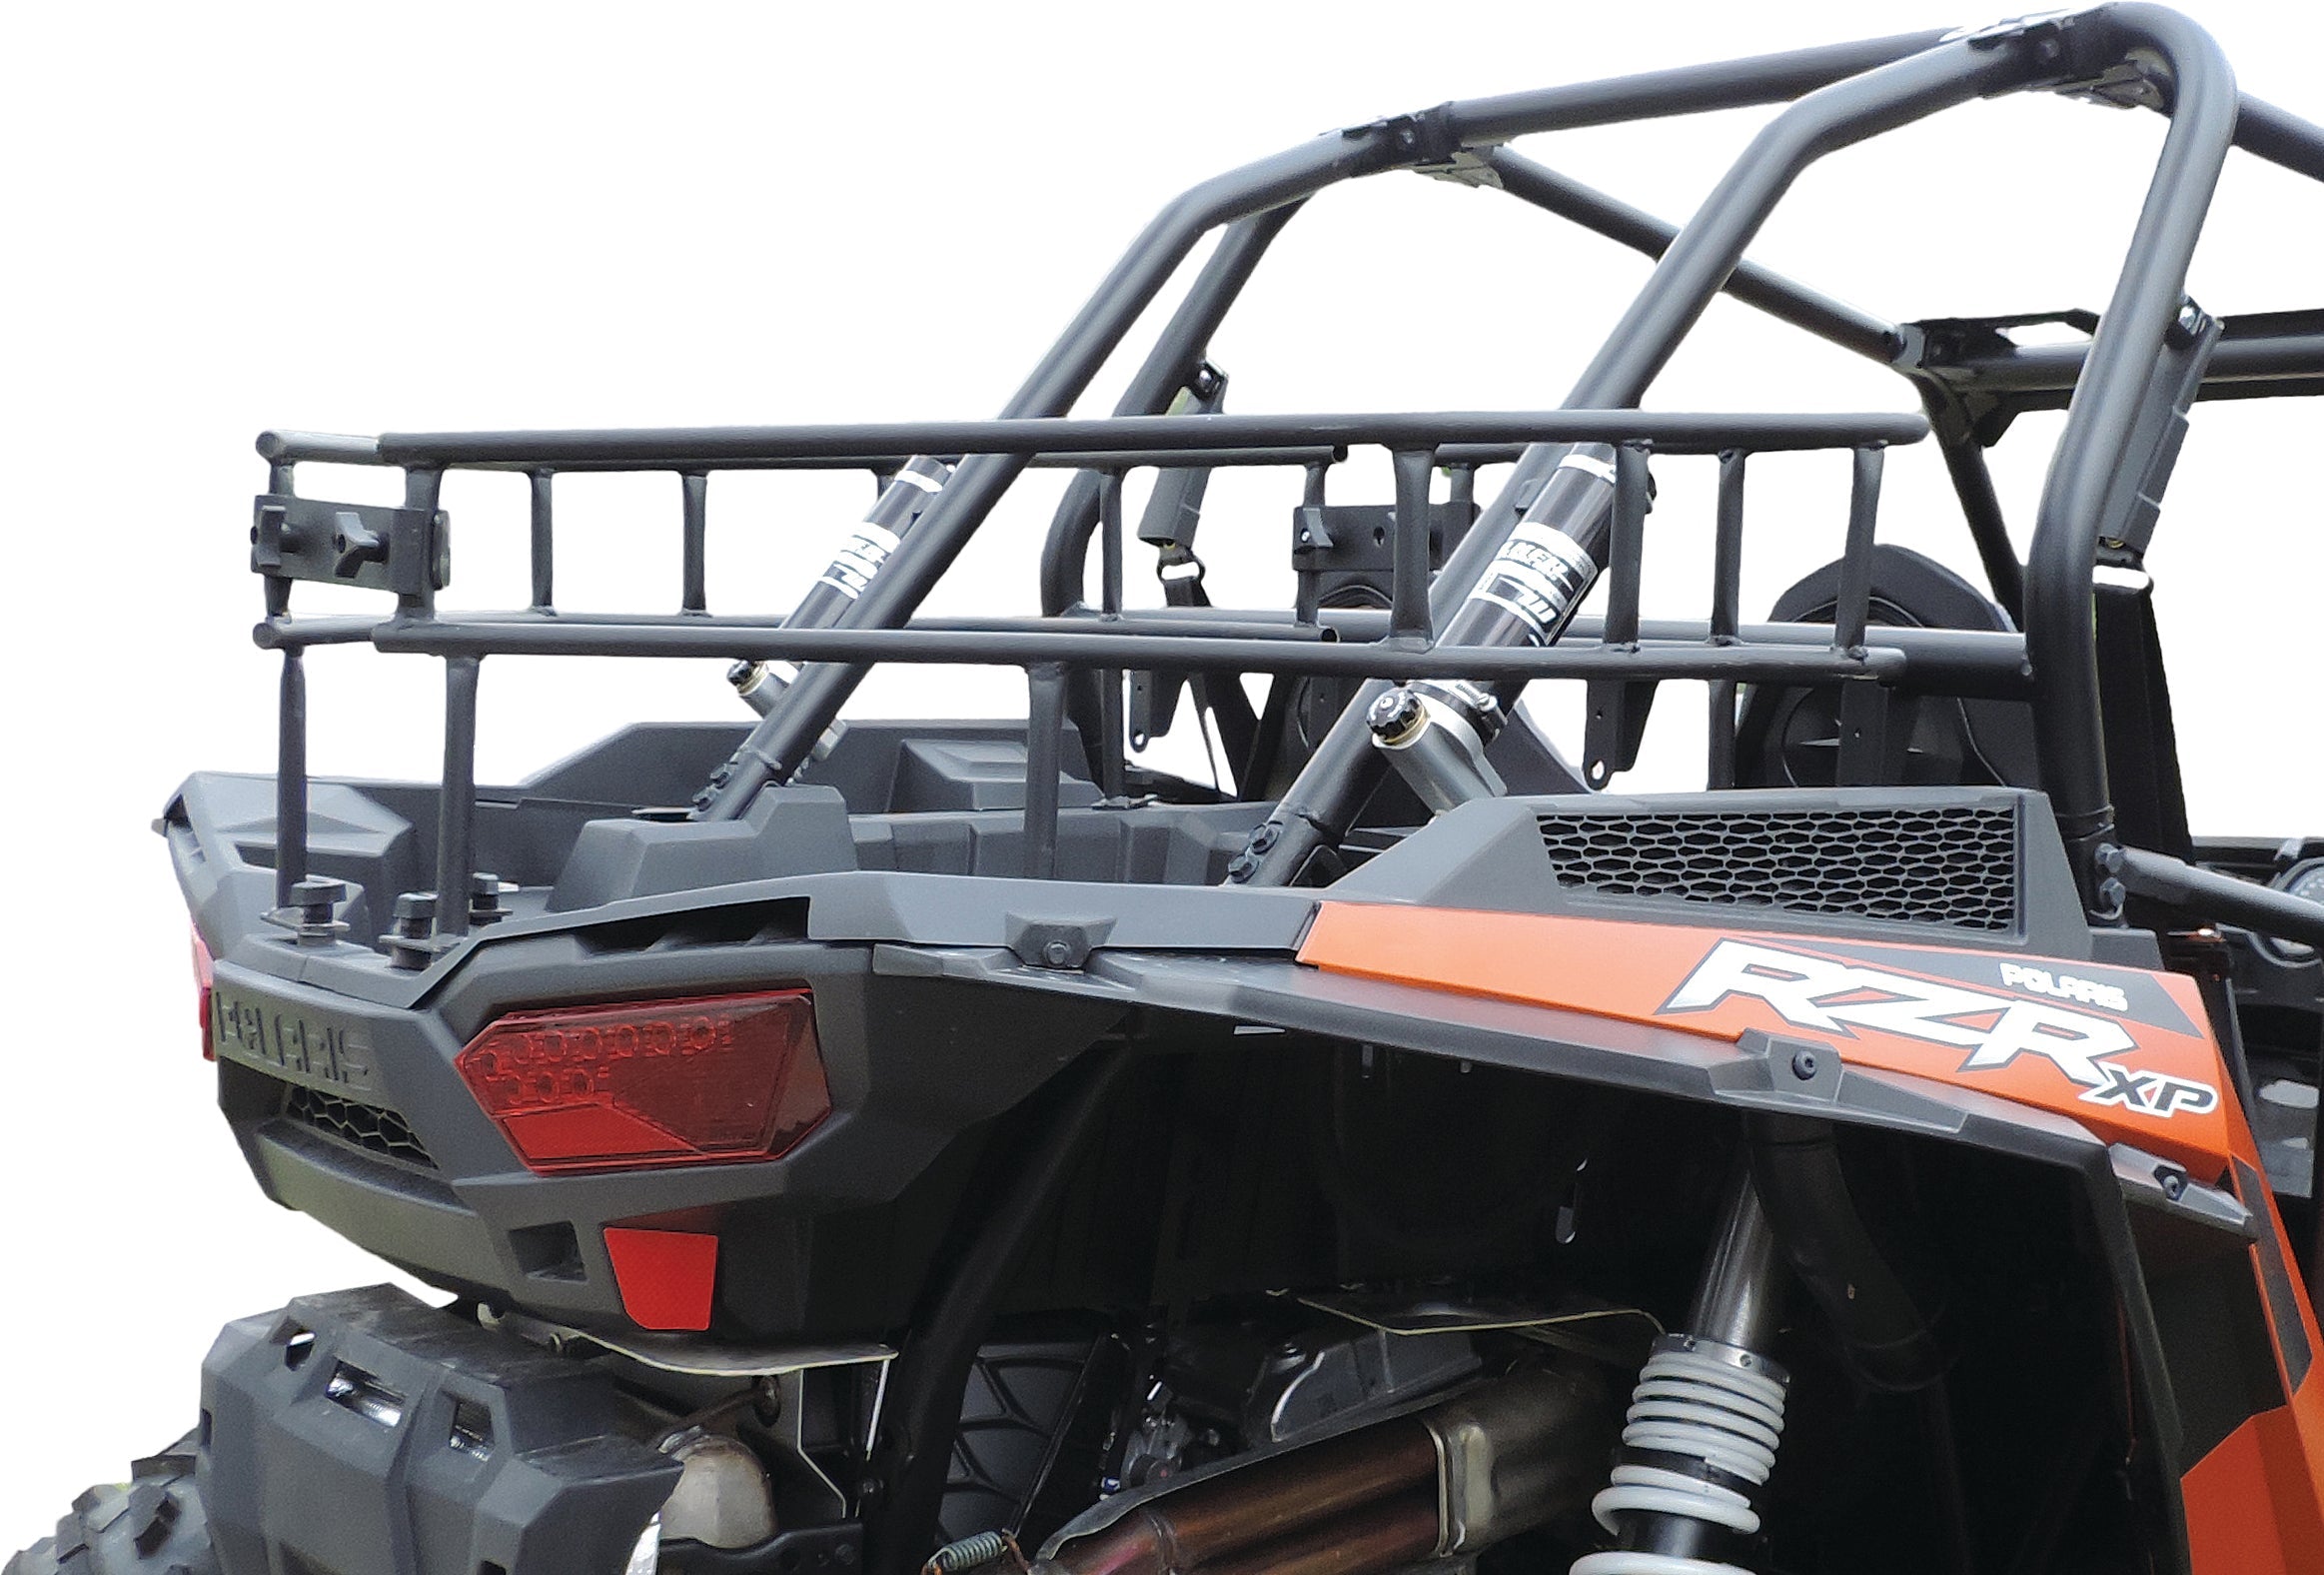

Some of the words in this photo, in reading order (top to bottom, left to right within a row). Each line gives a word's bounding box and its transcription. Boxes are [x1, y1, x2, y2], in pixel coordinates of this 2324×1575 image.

[1663, 937, 2138, 1087] RZR
[2085, 1063, 2217, 1116] XP
[1999, 962, 2128, 1012] POLARIS
